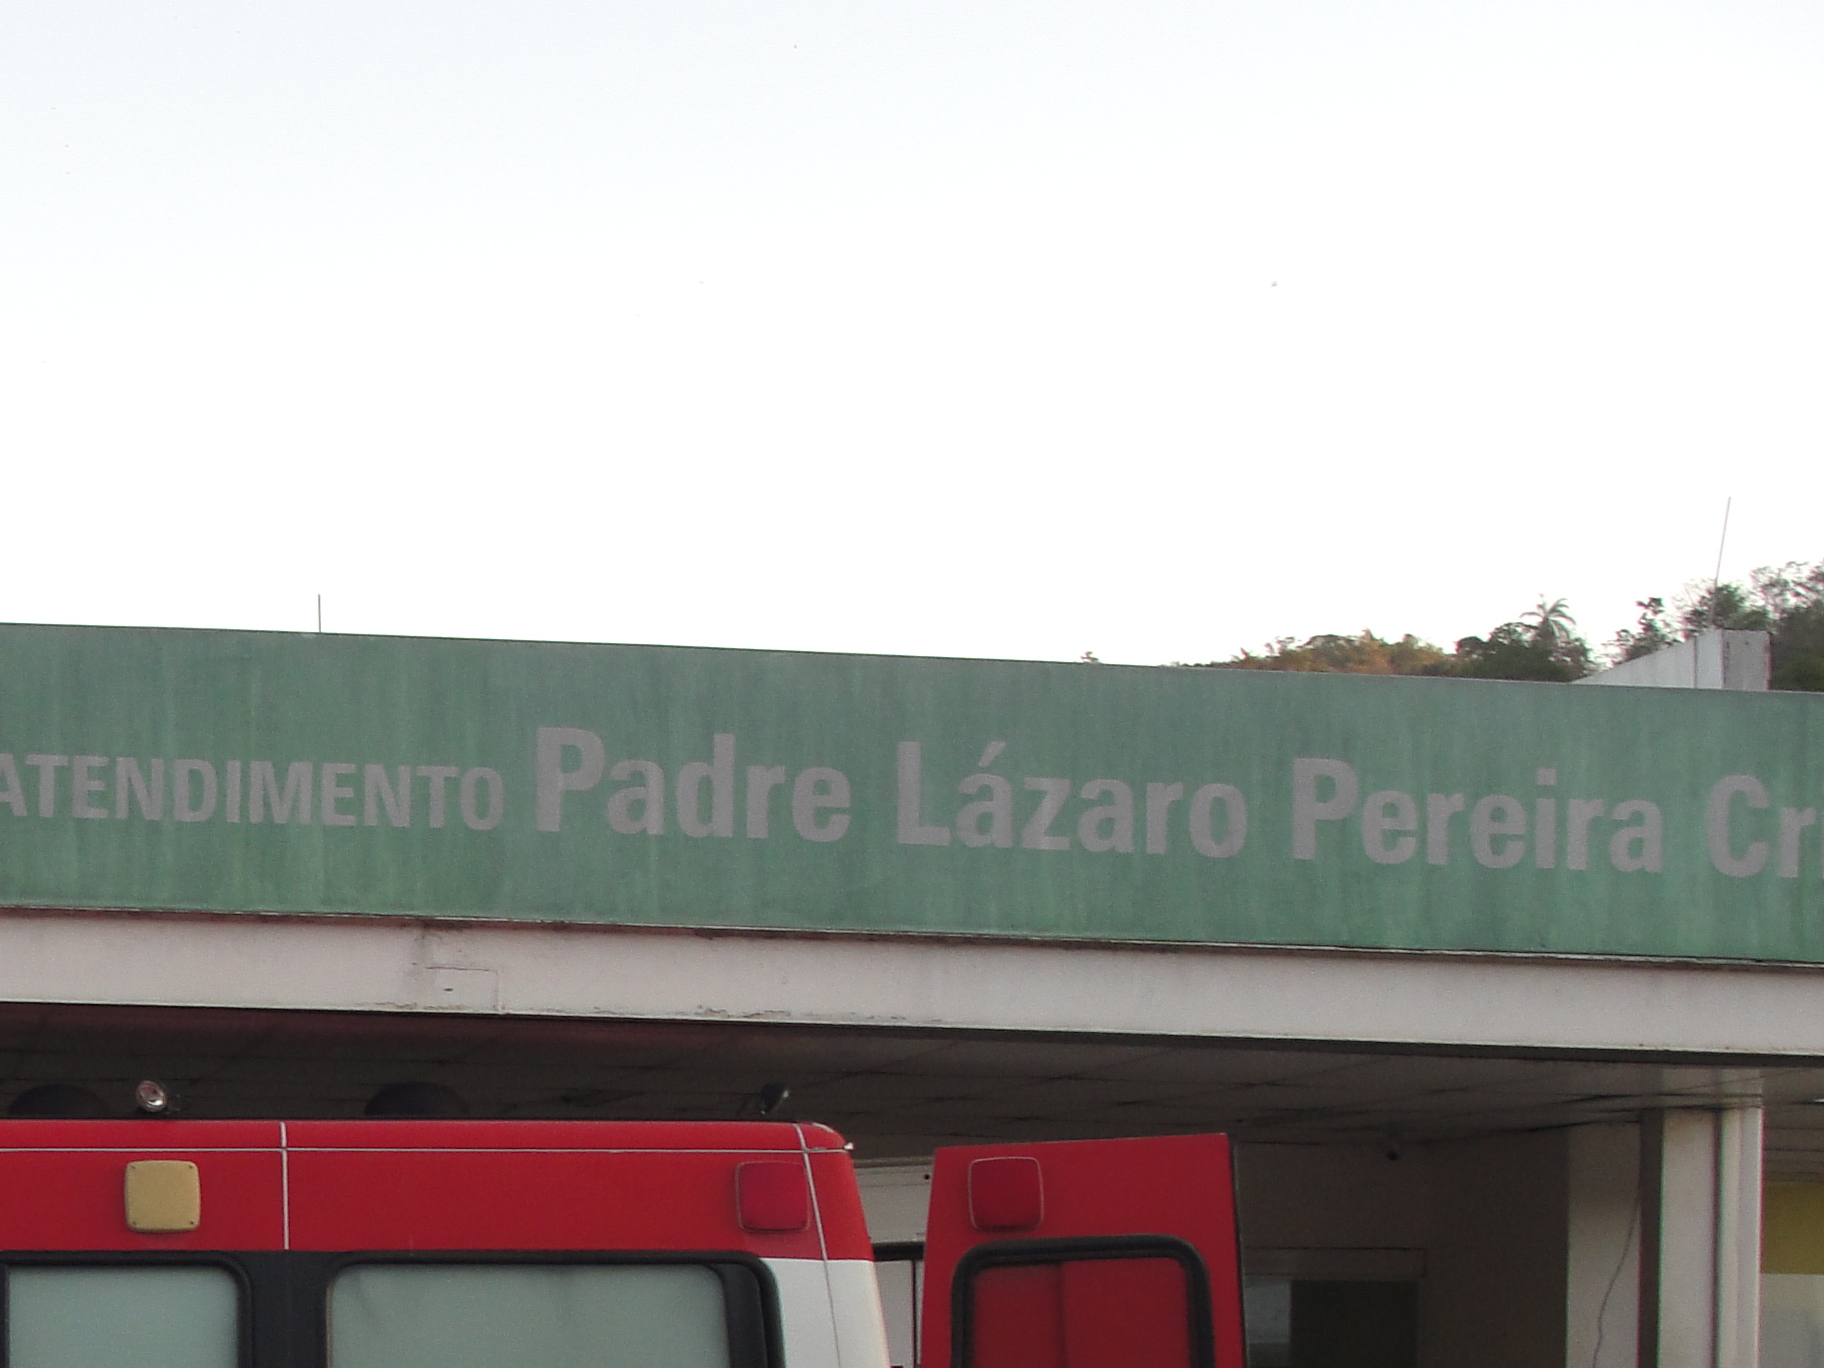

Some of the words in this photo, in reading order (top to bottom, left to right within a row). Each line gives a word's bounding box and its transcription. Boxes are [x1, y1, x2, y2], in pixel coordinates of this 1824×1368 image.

[536, 725, 853, 843] Padre
[895, 740, 1248, 860] Lázaro
[1290, 756, 1664, 874] Pereira
[1706, 773, 1824, 879] Cr
